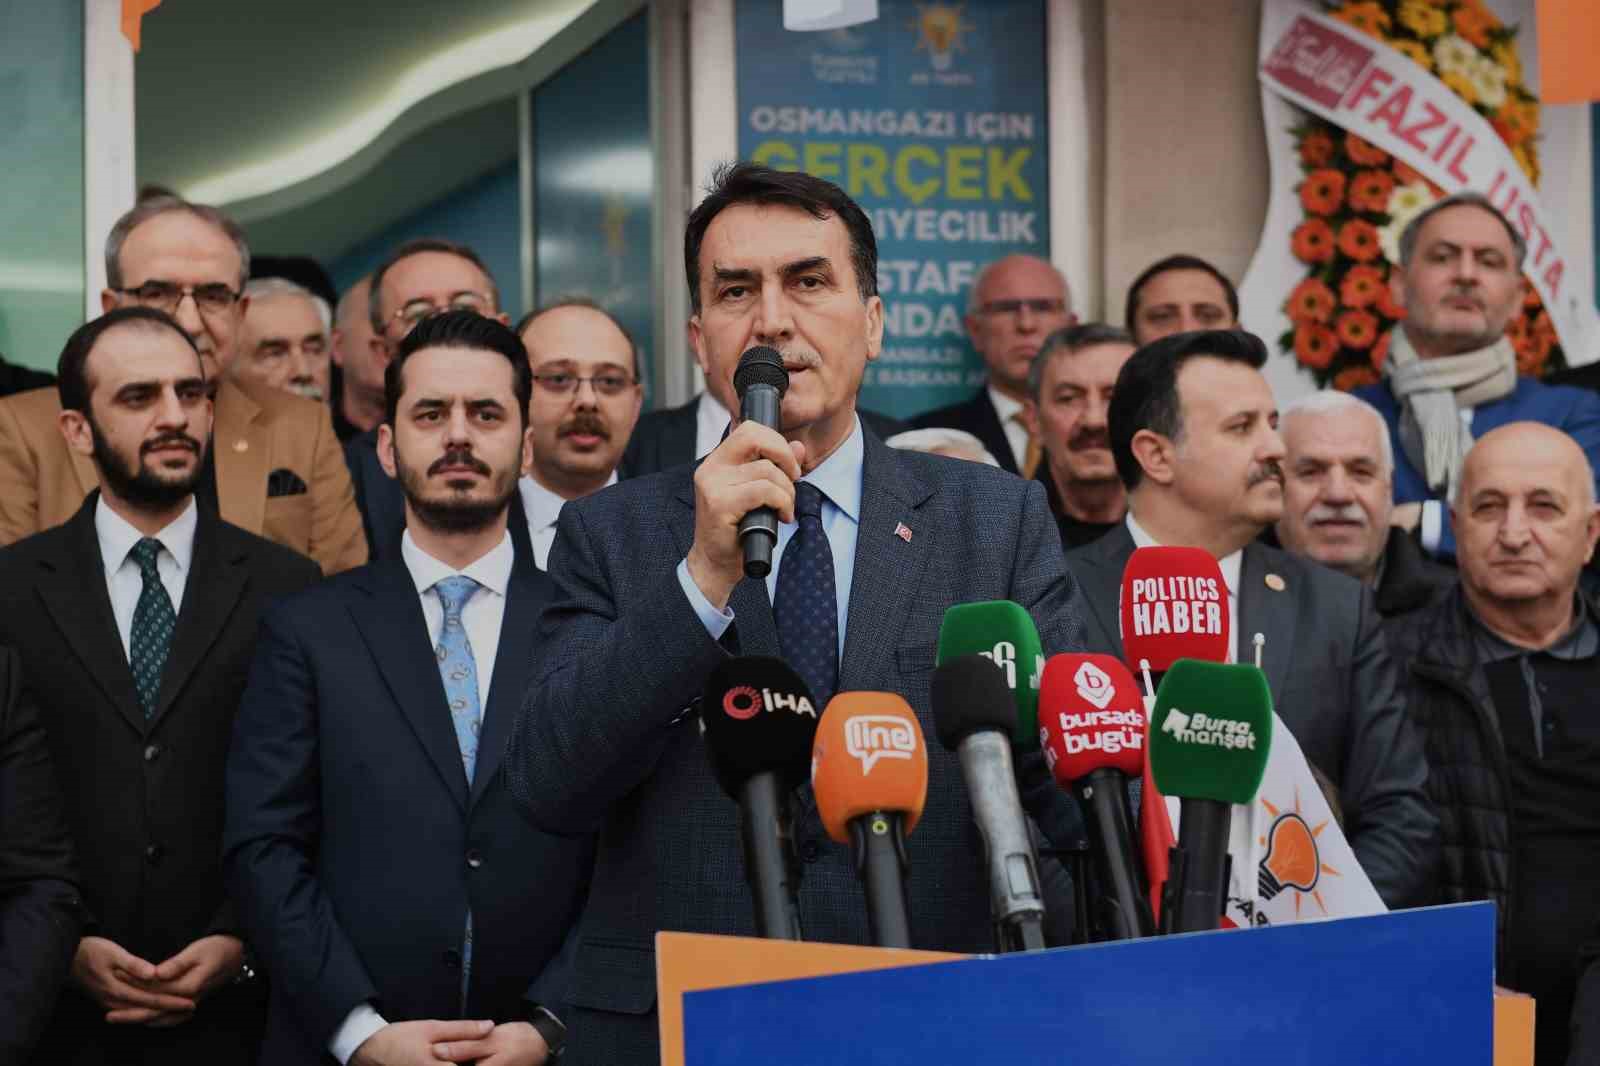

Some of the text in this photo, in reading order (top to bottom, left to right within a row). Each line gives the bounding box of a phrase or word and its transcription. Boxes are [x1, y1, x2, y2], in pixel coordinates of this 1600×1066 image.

[1348, 67, 1477, 185] FAZIL
[1132, 577, 1219, 602] POLITICS
[1133, 601, 1221, 636] HABER
[762, 688, 817, 718] İHA
[854, 716, 912, 750] line
[1190, 713, 1250, 735] Bursa
[1178, 729, 1256, 750] manşet
